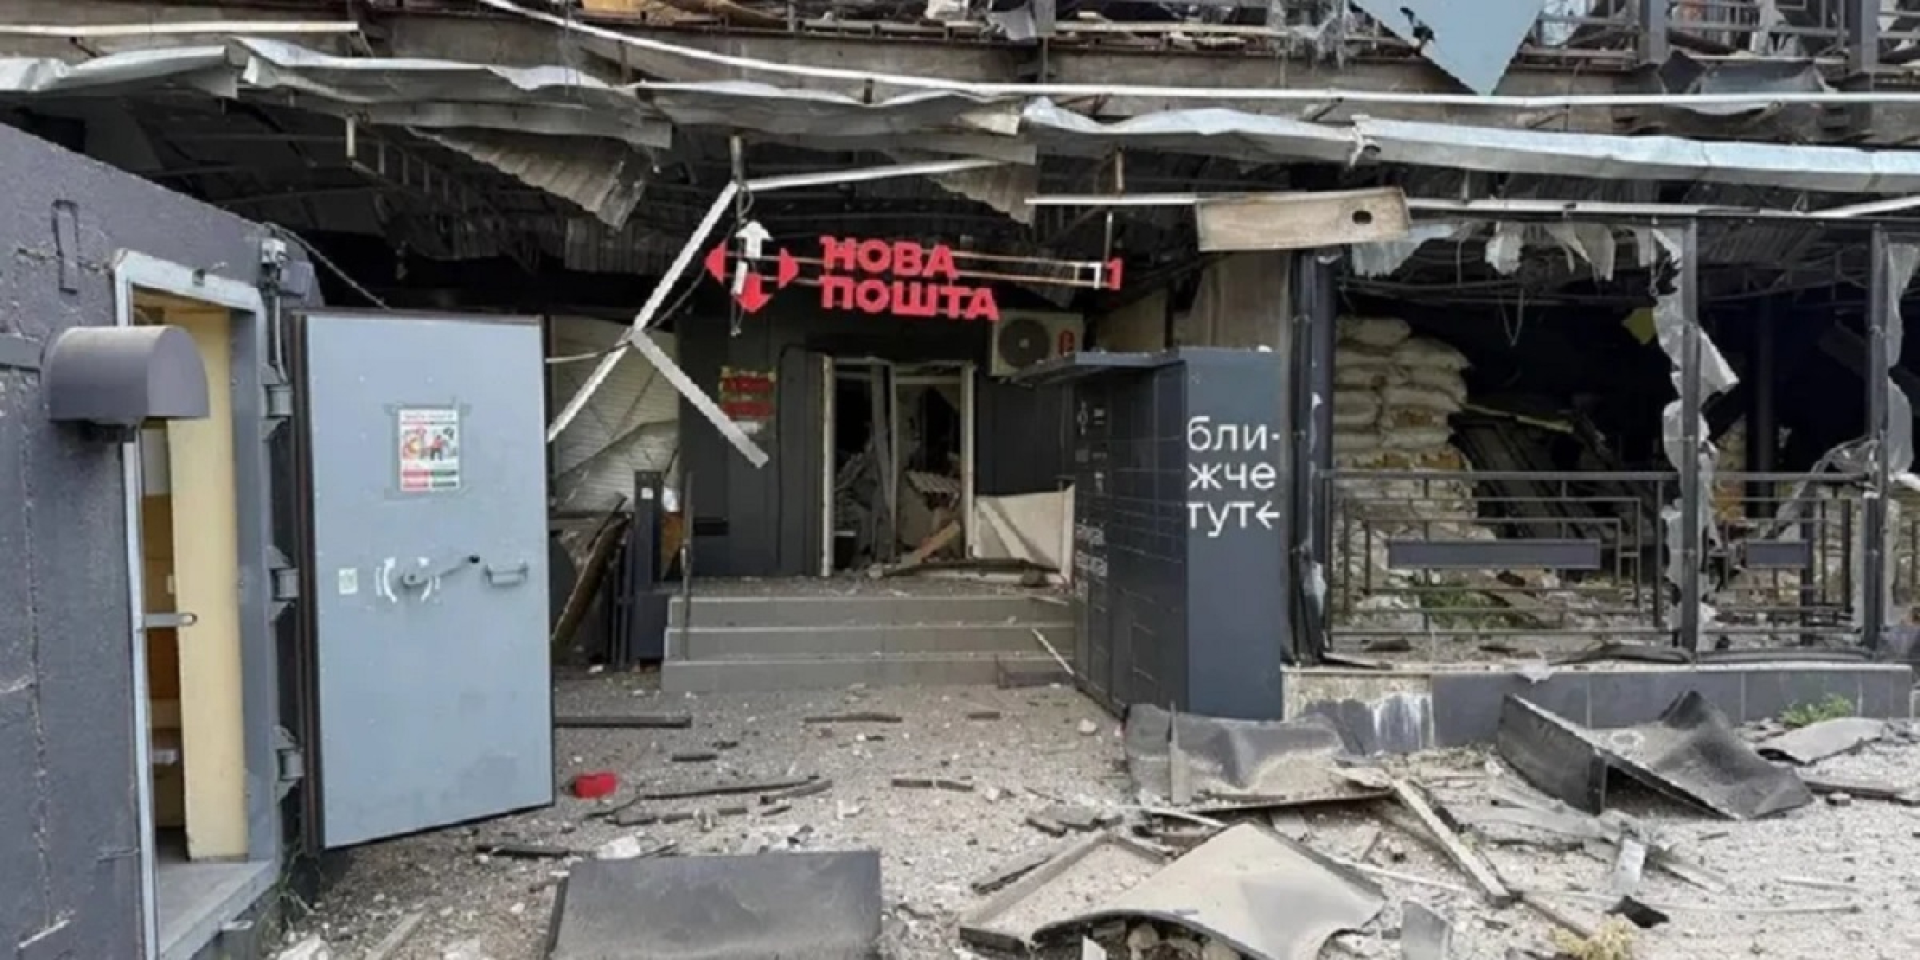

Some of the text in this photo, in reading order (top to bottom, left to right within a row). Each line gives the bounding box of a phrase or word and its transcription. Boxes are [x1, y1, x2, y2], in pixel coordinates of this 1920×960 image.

[819, 235, 960, 280] НОВА
[819, 275, 999, 321] ПОШТА
[1188, 462, 1277, 491] жче
[1186, 501, 1256, 538] тут
